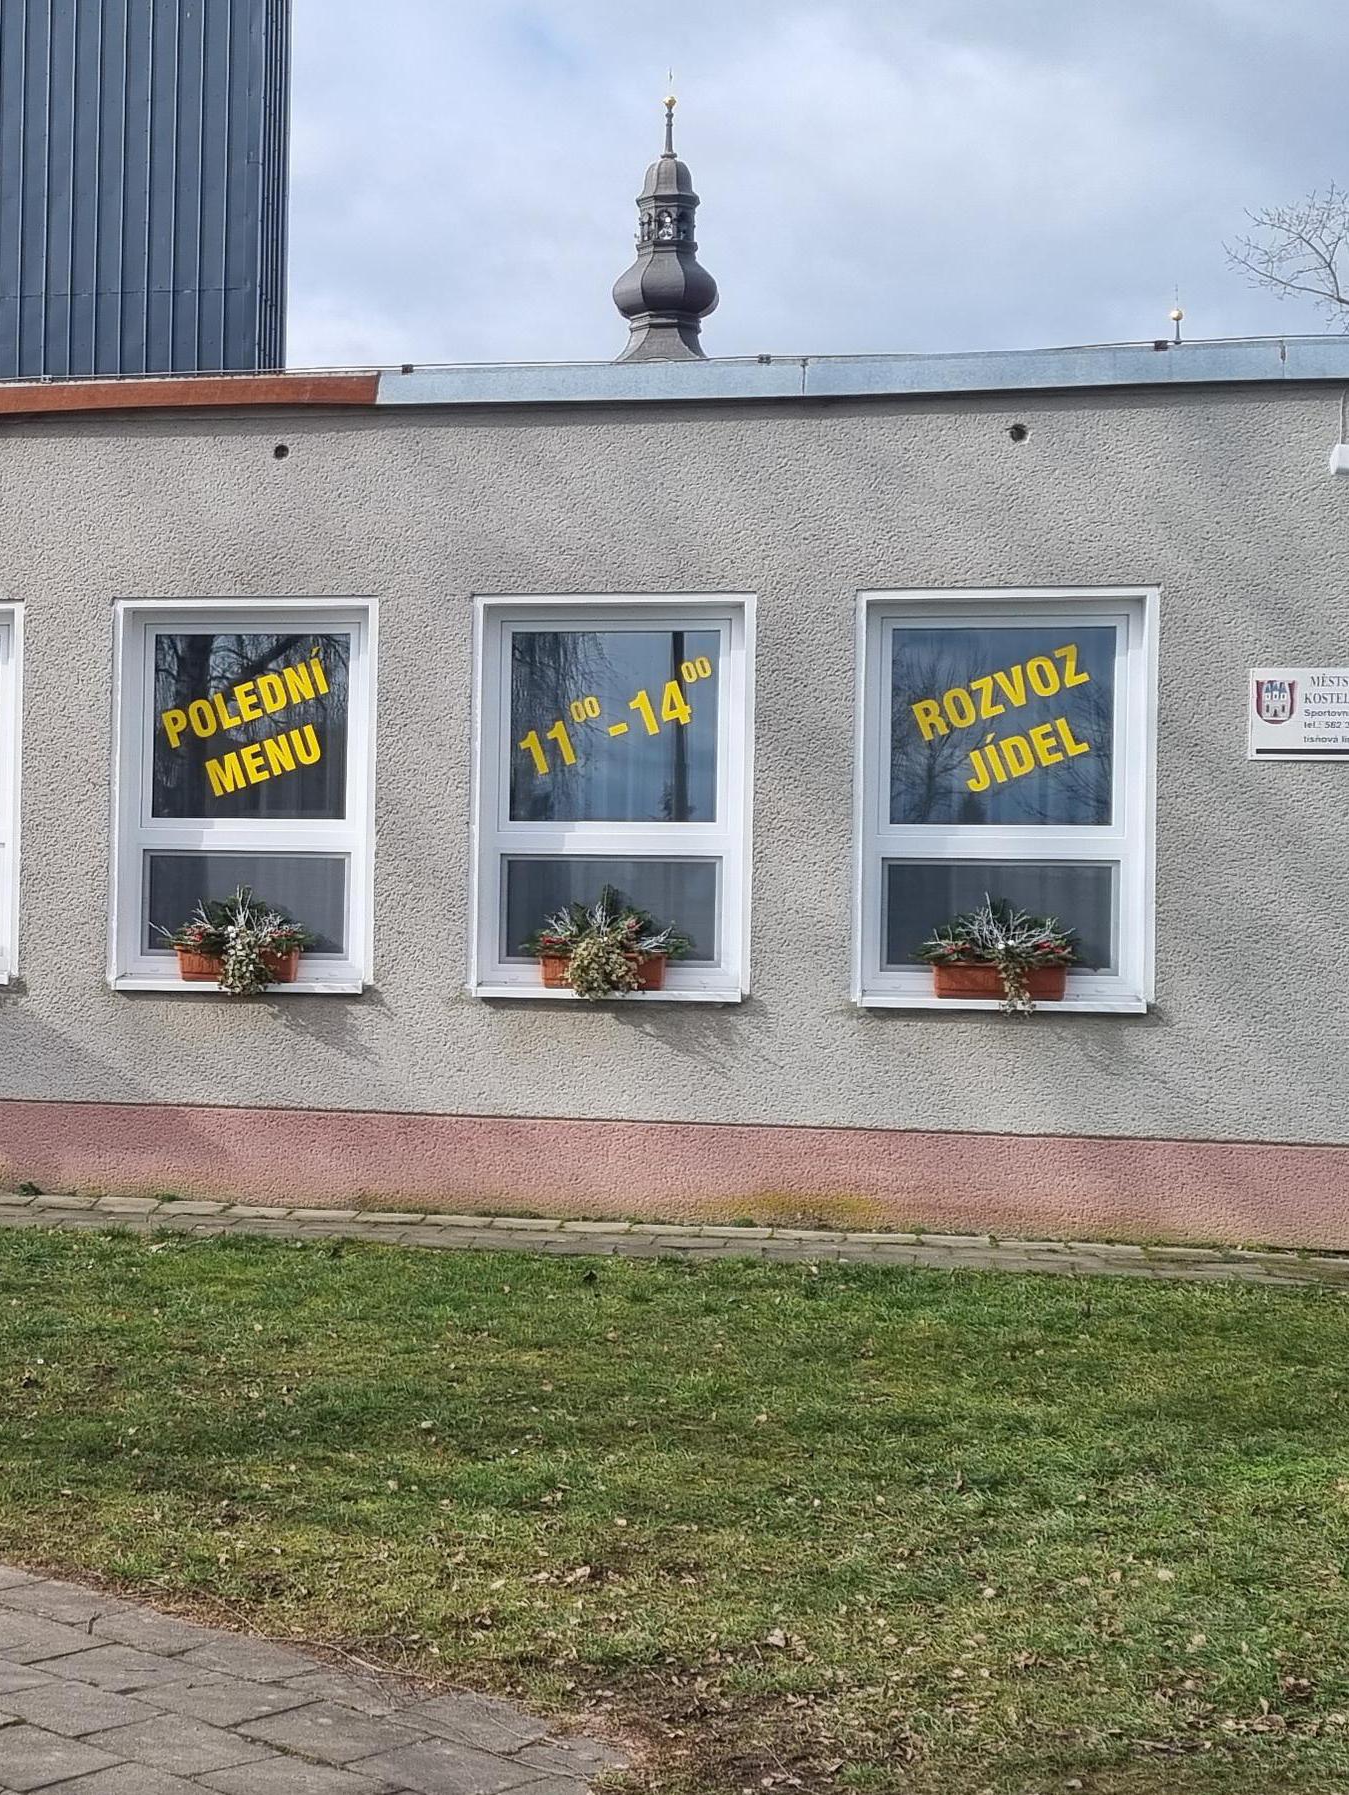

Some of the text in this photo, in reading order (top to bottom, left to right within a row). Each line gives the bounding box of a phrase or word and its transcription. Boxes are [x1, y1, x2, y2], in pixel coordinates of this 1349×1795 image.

[161, 646, 329, 749] POLEDNÍ
[911, 643, 1090, 741] ROZVOZ
[205, 723, 321, 797] MENU
[966, 717, 1090, 792] JÍDEL
